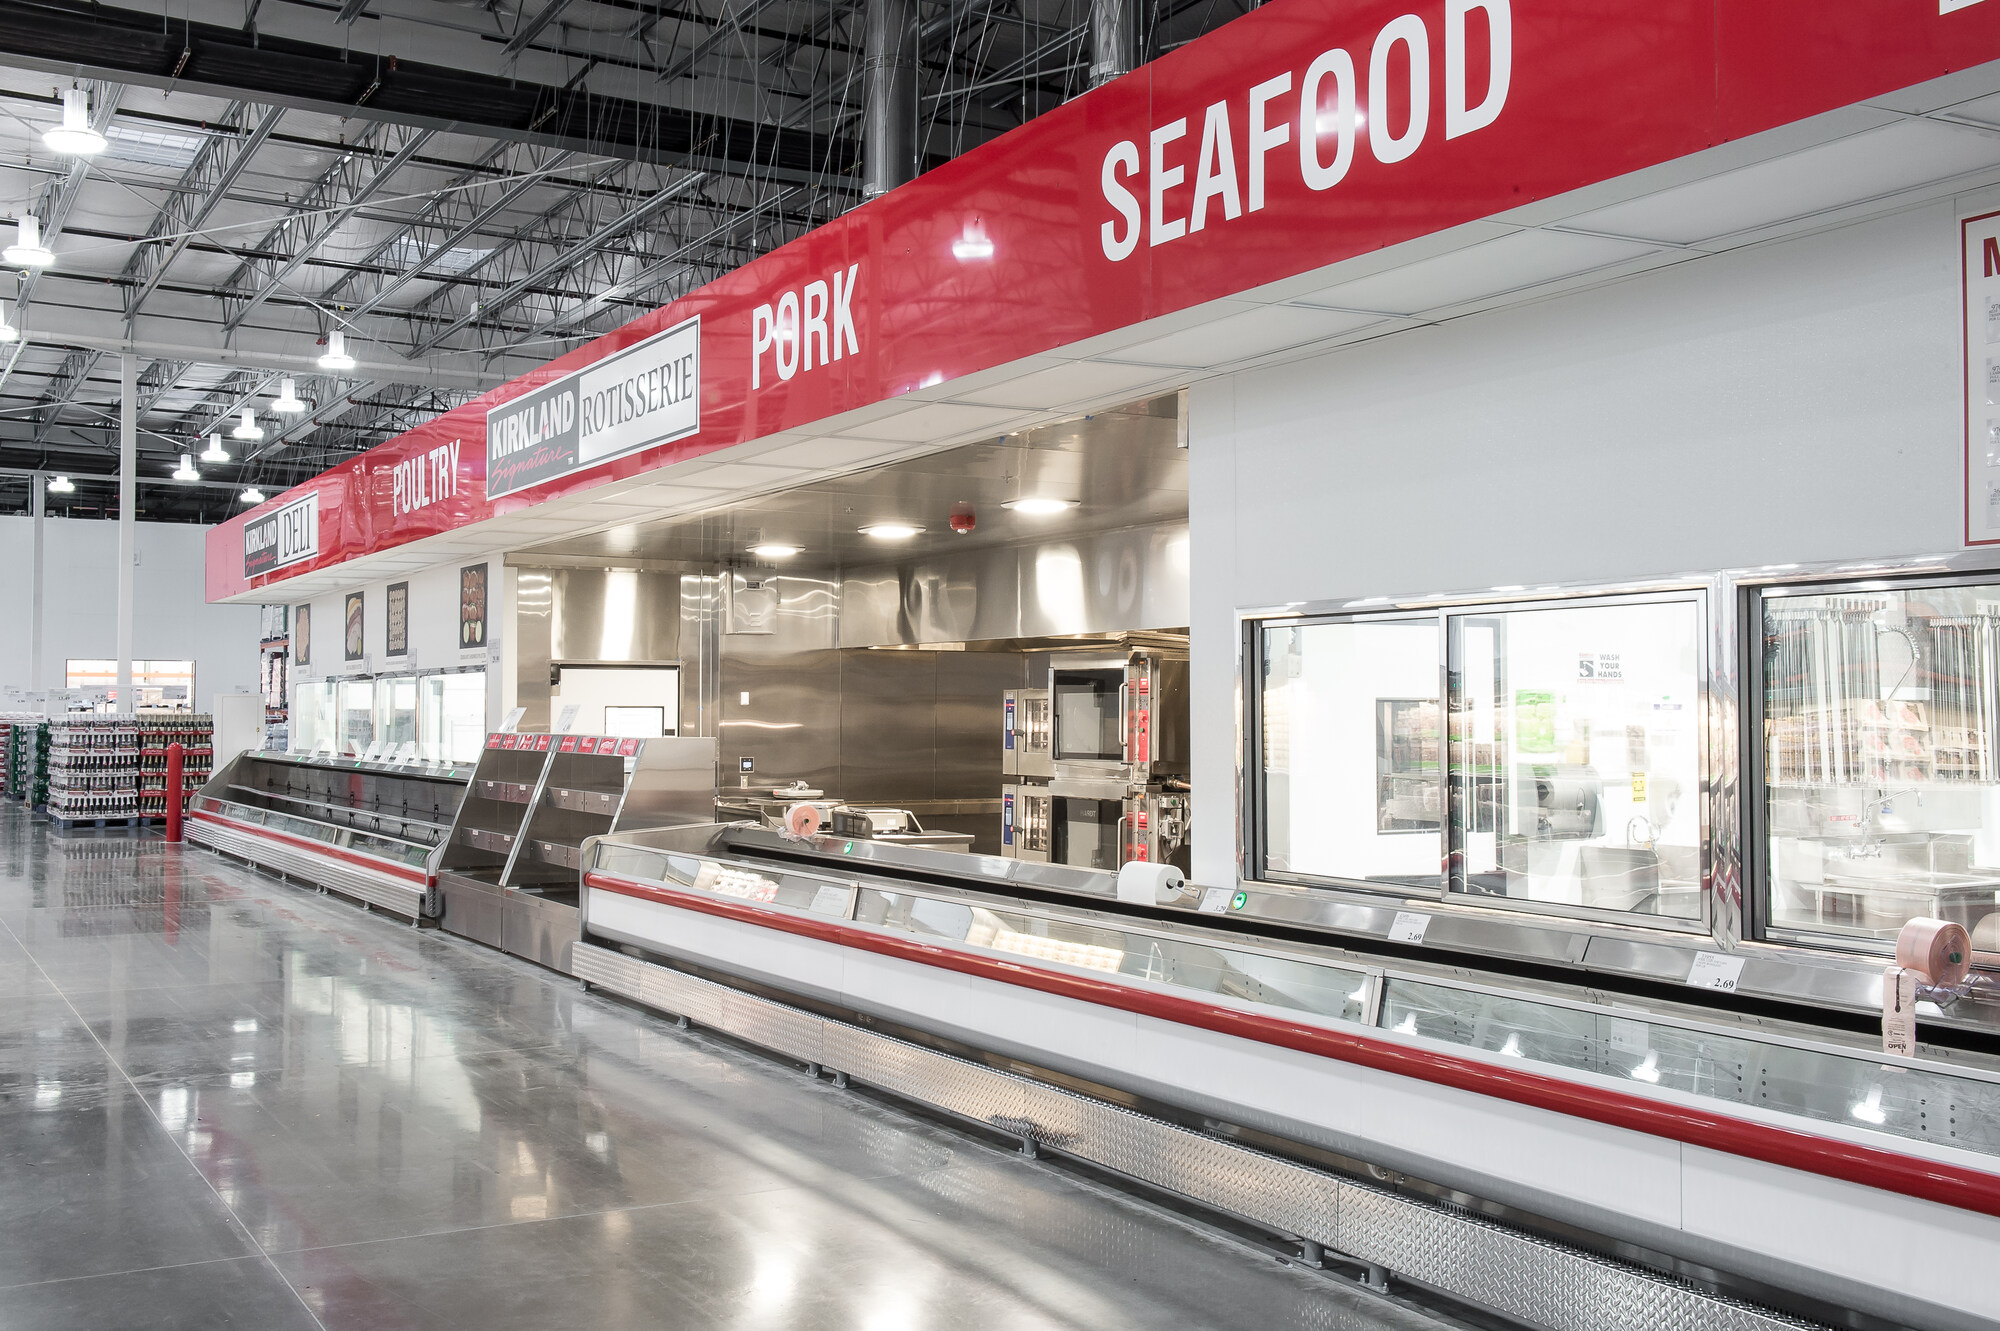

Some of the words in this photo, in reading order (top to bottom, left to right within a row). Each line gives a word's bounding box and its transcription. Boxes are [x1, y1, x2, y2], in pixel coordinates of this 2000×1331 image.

[1101, 0, 1512, 262] SEAFOOD
[752, 263, 860, 390] PORK
[581, 353, 693, 438] ROTISSERIE
[492, 390, 575, 461] KIRKLAND
[393, 438, 461, 517] POULTRY
[492, 445, 573, 492] Signature
[246, 520, 277, 556] KIRKLAND
[283, 504, 310, 558] DELI
[1080, 809, 1097, 817] ARDT
[1407, 931, 1422, 941] 2.69
[1714, 977, 1735, 989] 2.69
